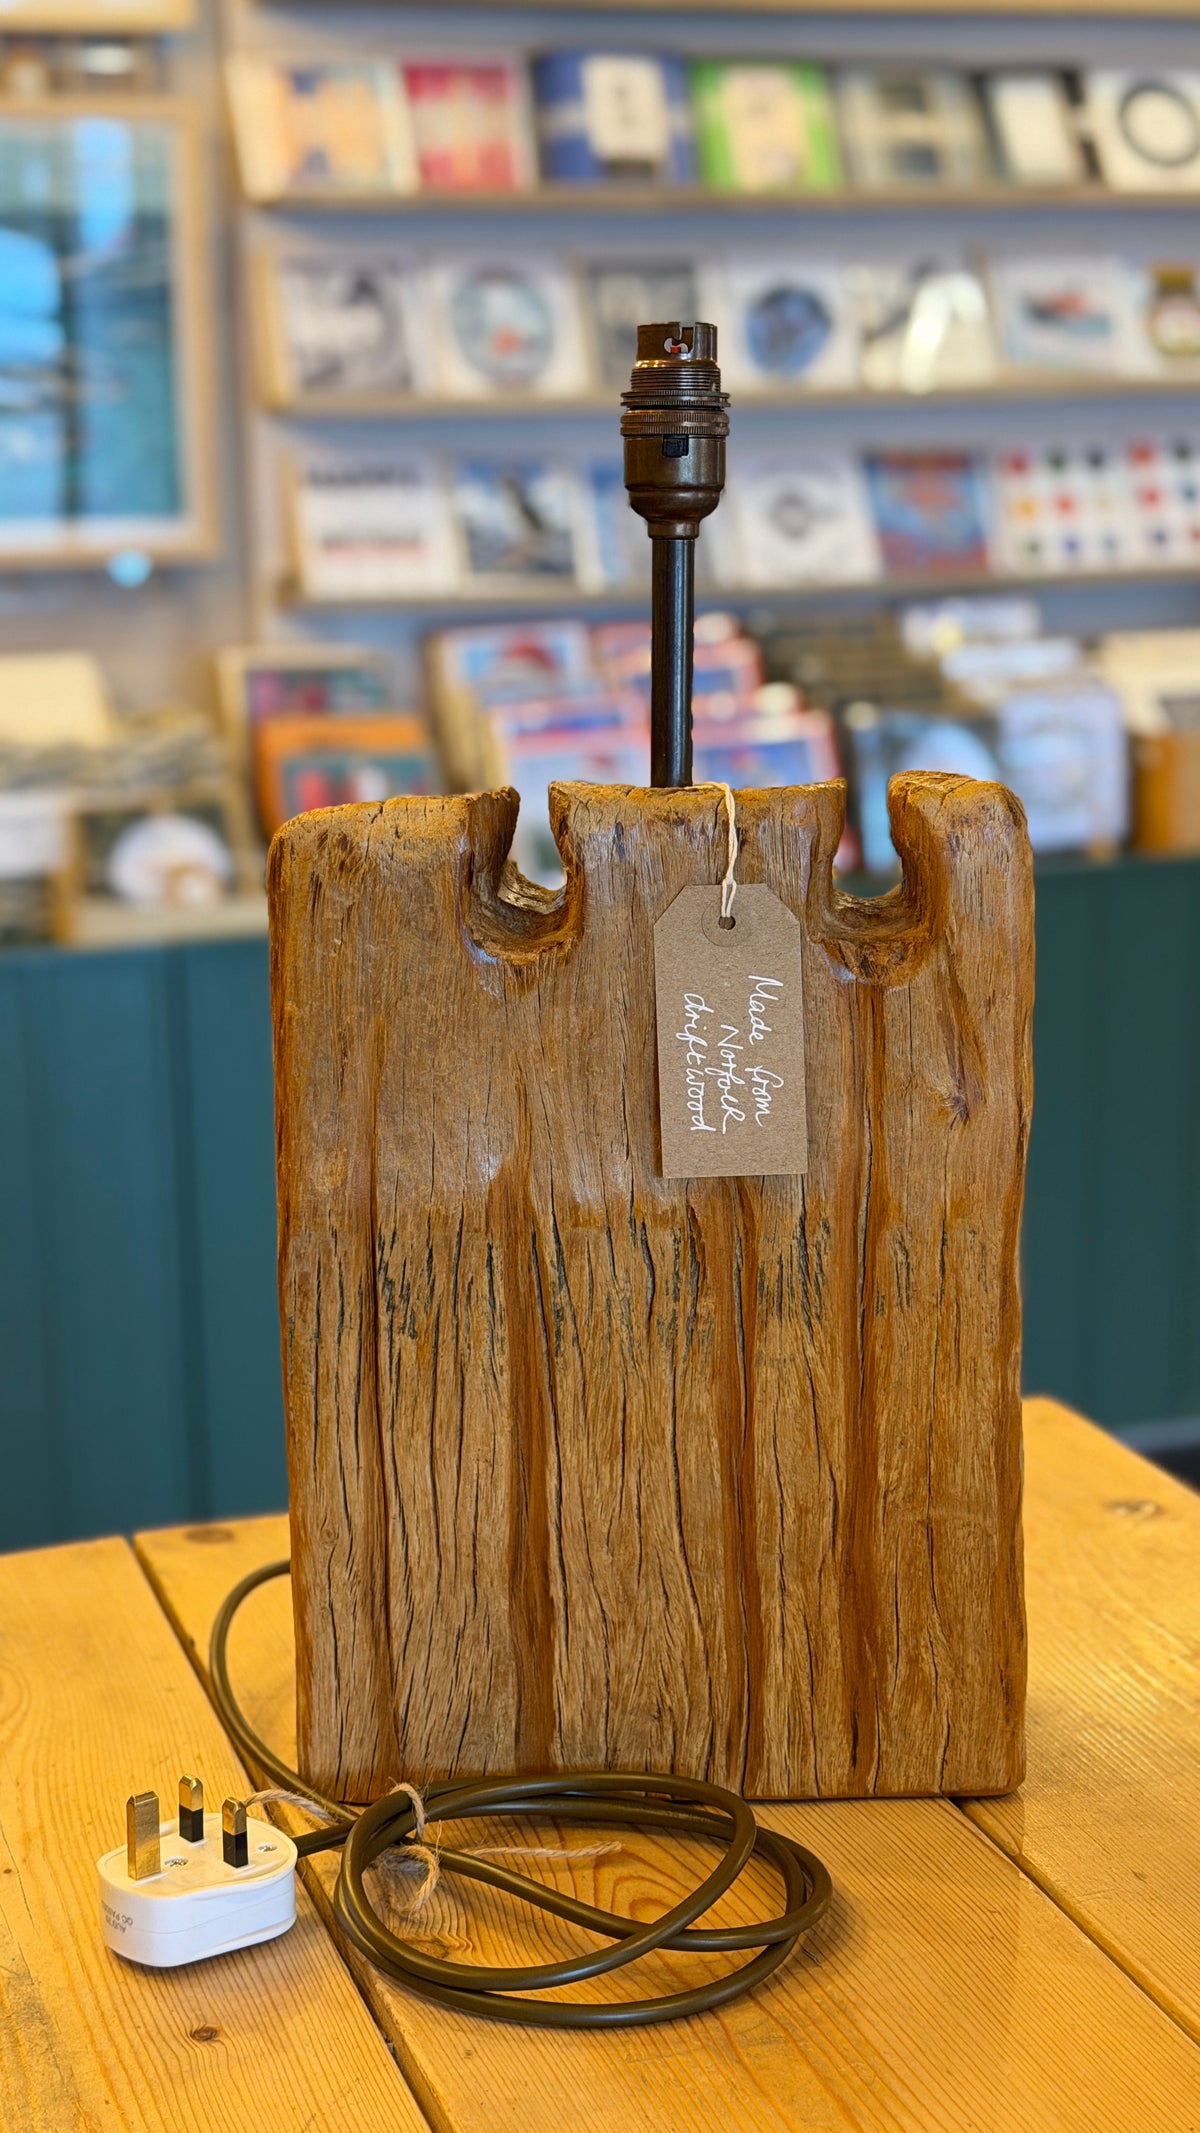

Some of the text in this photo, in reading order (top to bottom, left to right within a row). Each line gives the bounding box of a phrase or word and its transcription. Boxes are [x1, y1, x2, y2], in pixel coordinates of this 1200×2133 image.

[704, 1024, 746, 1134] Norfolk
[744, 975, 784, 1127] Made from
